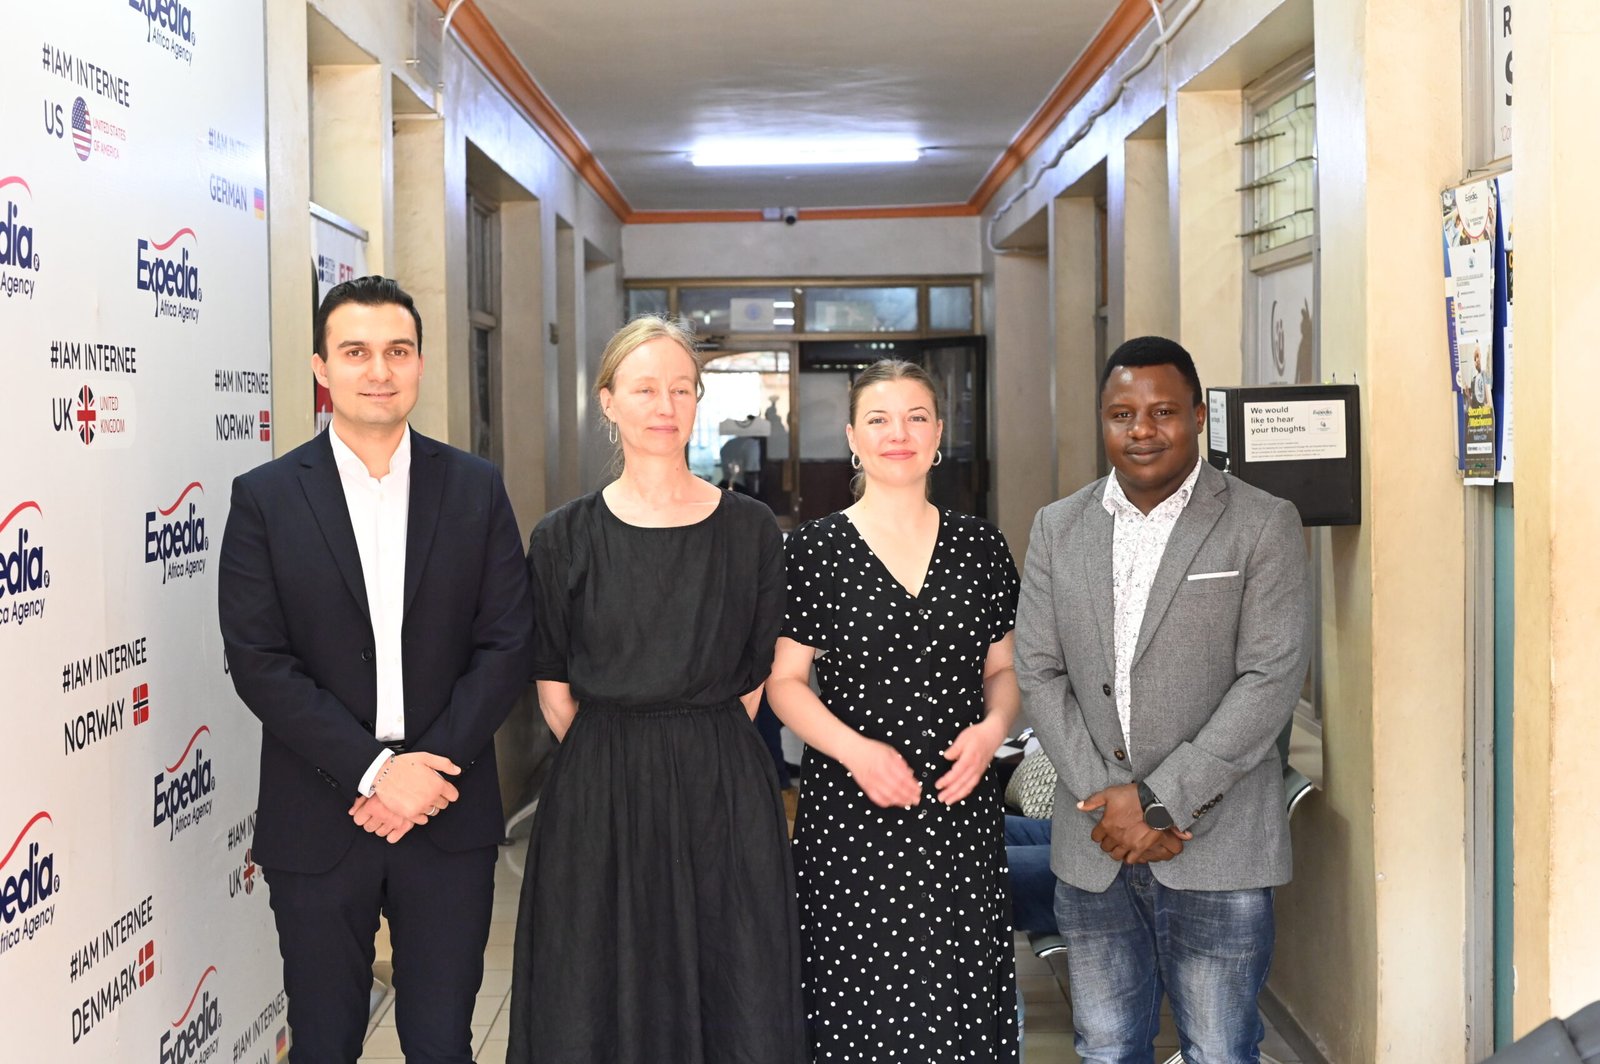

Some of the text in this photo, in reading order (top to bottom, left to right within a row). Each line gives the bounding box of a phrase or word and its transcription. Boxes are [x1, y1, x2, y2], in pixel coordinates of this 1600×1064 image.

[42, 42, 130, 108] #IAM INTERNEE
[44, 99, 64, 139] US
[209, 173, 248, 212] GERMAN
[0, 271, 35, 300] Agency
[137, 238, 198, 318] Expedia
[160, 299, 199, 324] Africa Agency
[51, 340, 137, 374] #IAM INTERNEE
[214, 369, 269, 395] #IAM INTERNEE
[52, 397, 74, 432] UK
[99, 396, 119, 412] UNITED
[1265, 406, 1289, 414] would
[100, 418, 126, 434] KINGDOM
[215, 413, 255, 441] NORWAY
[1251, 427, 1269, 435] your
[1271, 425, 1306, 434] thoughts
[145, 502, 205, 585] Expedia
[167, 558, 206, 581] Africa Agency
[11, 598, 46, 626] Agency
[62, 637, 147, 694] #IAM INTERNEE
[64, 698, 125, 756] NORWAY
[153, 748, 212, 842] Expedia
[174, 799, 213, 836] Africa Agency
[228, 817, 246, 852] #IAM
[229, 865, 242, 898] UK
[22, 903, 56, 941] Agency
[69, 895, 153, 983] #IAM INTERNEE
[72, 960, 137, 1045] DENMARK
[233, 989, 285, 1063] #IAM INTERNEE
